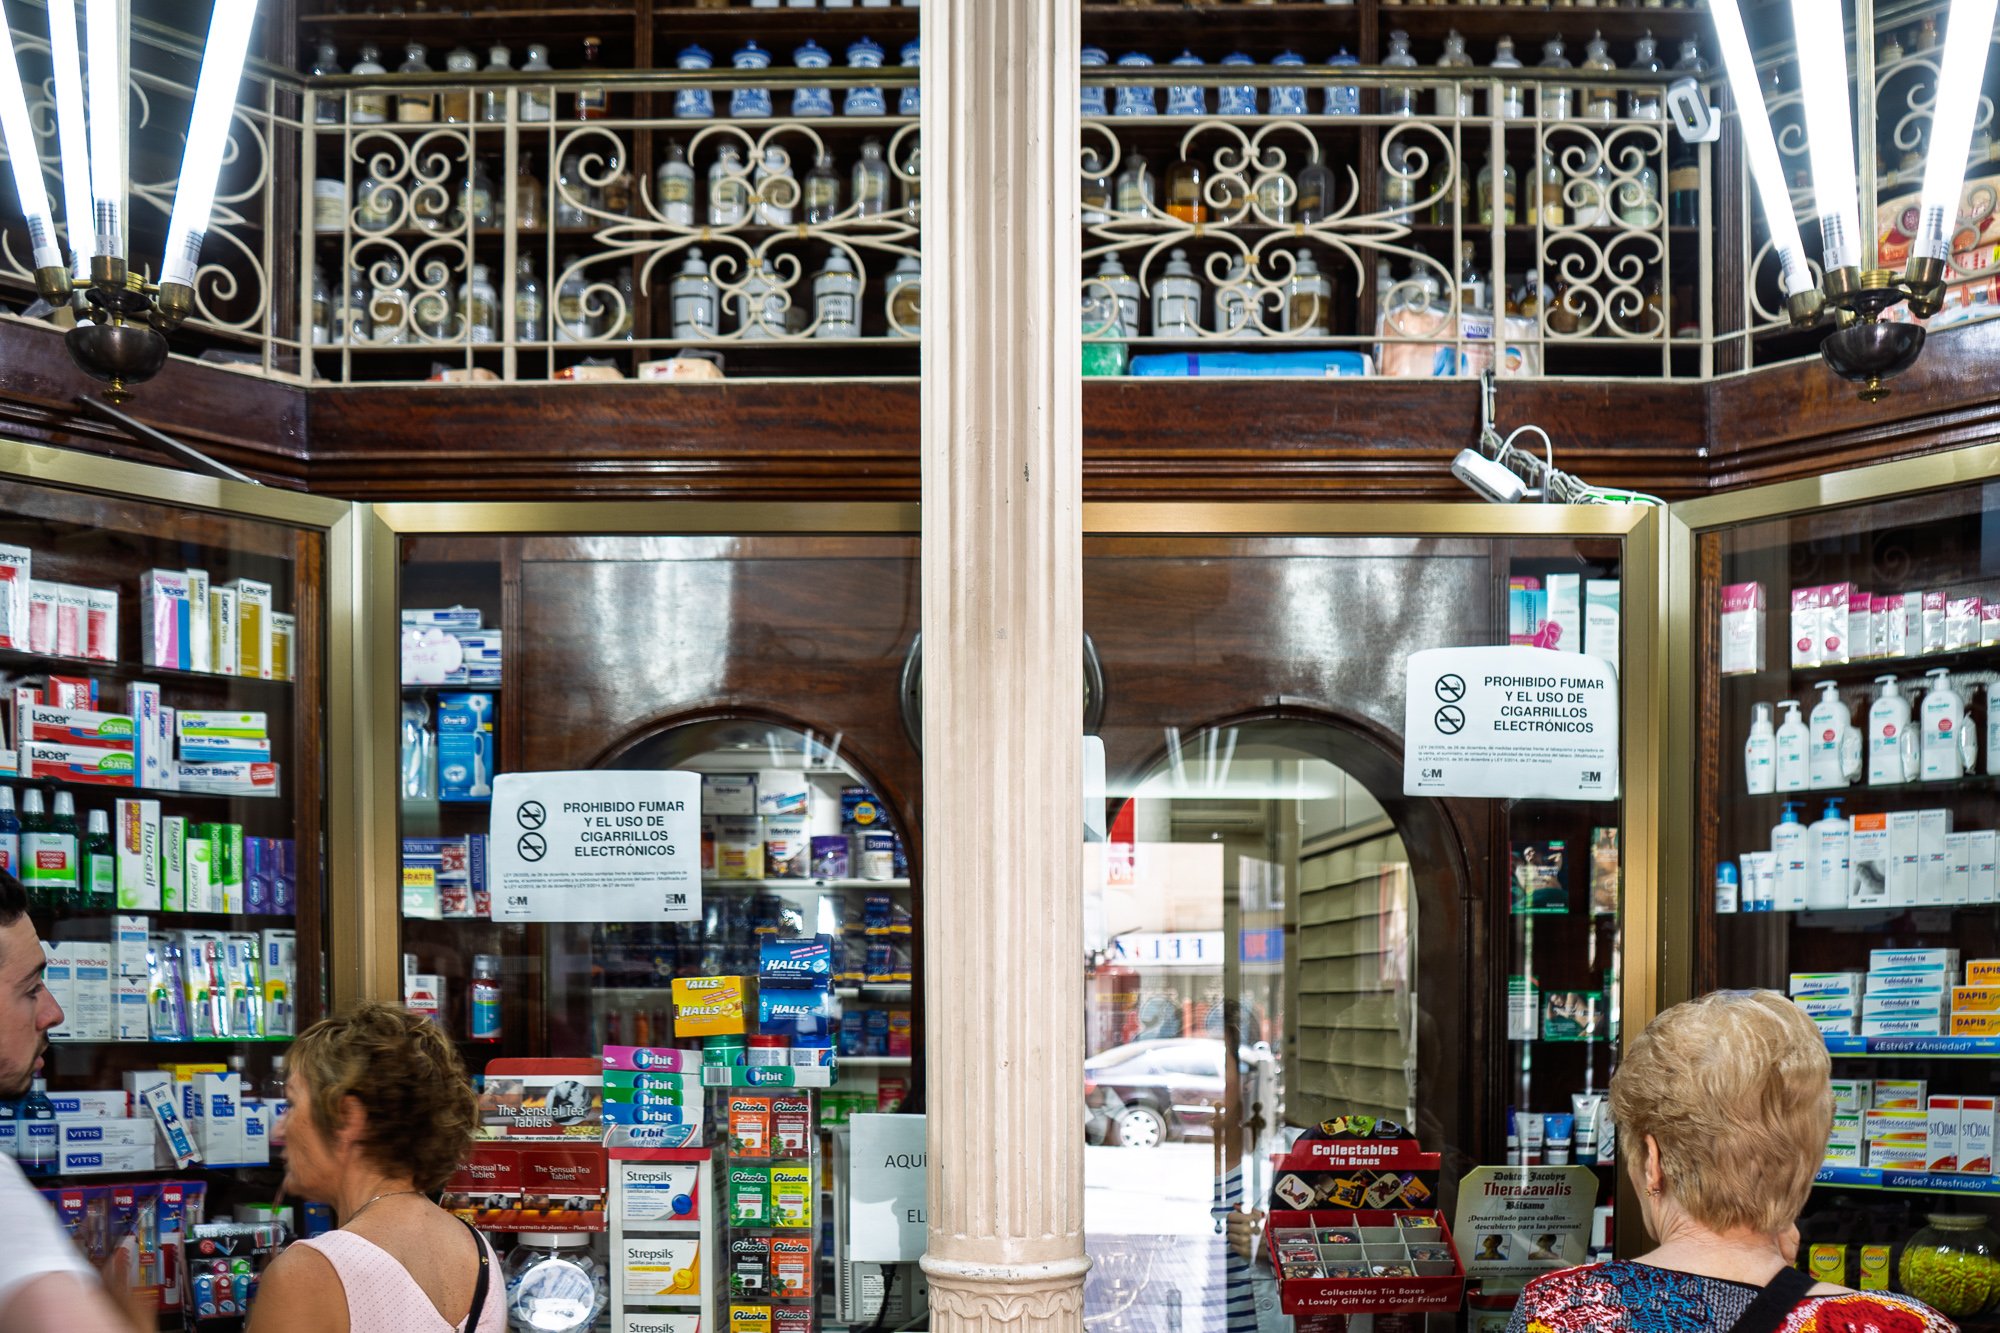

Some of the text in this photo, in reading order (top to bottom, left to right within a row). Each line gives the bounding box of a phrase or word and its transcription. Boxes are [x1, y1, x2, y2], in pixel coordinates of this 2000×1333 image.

[241, 584, 270, 596] Lacer
[1484, 676, 1604, 689] PROHIBIDO FUMAR
[1505, 692, 1584, 704] Y EL USO DE
[32, 710, 70, 724] Lacer
[1501, 706, 1588, 718] CIGARRILLOS
[101, 724, 132, 735] GRATIS
[1494, 719, 1594, 733] ELECTRÓNICOS
[32, 747, 70, 761] Lacer
[101, 759, 132, 769] GRATIS
[178, 765, 240, 777] Lacer Blanc
[564, 801, 685, 813] PROHIBIDO FUMAR
[584, 816, 664, 827] Y EL USO DE
[581, 831, 668, 842] CIGARRILLOS
[145, 822, 156, 887] Fluocaril
[575, 843, 675, 857] ELECTRÓNICOS
[766, 960, 811, 970] HALLS
[1958, 992, 1987, 1000] DAPIS
[681, 1005, 720, 1016] HALLS
[772, 1005, 810, 1014] HALLS
[1956, 1018, 1986, 1027] DAPIS
[1874, 1040, 1914, 1051] ¿Estrés?
[1916, 1041, 1971, 1051] ¿Ansiedad?
[636, 1051, 673, 1066] Orbit
[748, 1070, 783, 1083] Orbit
[636, 1076, 673, 1089] Orbit
[636, 1092, 673, 1105] Orbit
[54, 1101, 78, 1109] ITIS
[497, 1104, 585, 1117] The Sensual Tea
[732, 1101, 767, 1112] Ricola
[774, 1101, 808, 1112] Ricola
[636, 1108, 673, 1122] Orbit
[514, 1116, 552, 1128] Tablets
[30, 1126, 56, 1134] VITIS
[69, 1130, 100, 1138] VITIS
[630, 1127, 665, 1138] Orbit
[1929, 1121, 1957, 1137] STODAL
[1962, 1122, 1991, 1137] STODAL
[1312, 1144, 1399, 1156] Collectables
[69, 1156, 100, 1165] VITIS
[1329, 1157, 1380, 1165] Tin Boxes
[470, 1163, 496, 1172] Sensual
[498, 1164, 510, 1172] Tea
[535, 1165, 590, 1174] The Sensual Tea
[472, 1171, 496, 1179] Tablets
[552, 1172, 576, 1180] Tablets
[627, 1171, 672, 1183] Strepsils
[732, 1172, 767, 1182] Ricola
[774, 1172, 808, 1182] Ricola
[1816, 1171, 1834, 1180] os?
[1892, 1177, 1986, 1189] ¿Gripe? ¿Resfriado?
[1484, 1182, 1572, 1196] Theracavalis
[115, 1195, 133, 1204] PHB
[164, 1192, 181, 1201] PHB
[64, 1199, 82, 1208] PHB
[1505, 1201, 1545, 1210] Bálsamo
[907, 1209, 927, 1223] EL
[1547, 1223, 1582, 1231] personas!
[733, 1241, 768, 1252] Ricola
[774, 1243, 808, 1253] Ricola
[628, 1248, 673, 1260] Strepsils
[1320, 1288, 1377, 1296] Collectables
[1308, 1298, 1337, 1306] Lovely
[1341, 1297, 1359, 1305] Gift
[1389, 1296, 1414, 1304] Good
[734, 1310, 768, 1320] Ricola
[775, 1310, 809, 1320] Ricola
[629, 1322, 674, 1333] Strepsils
